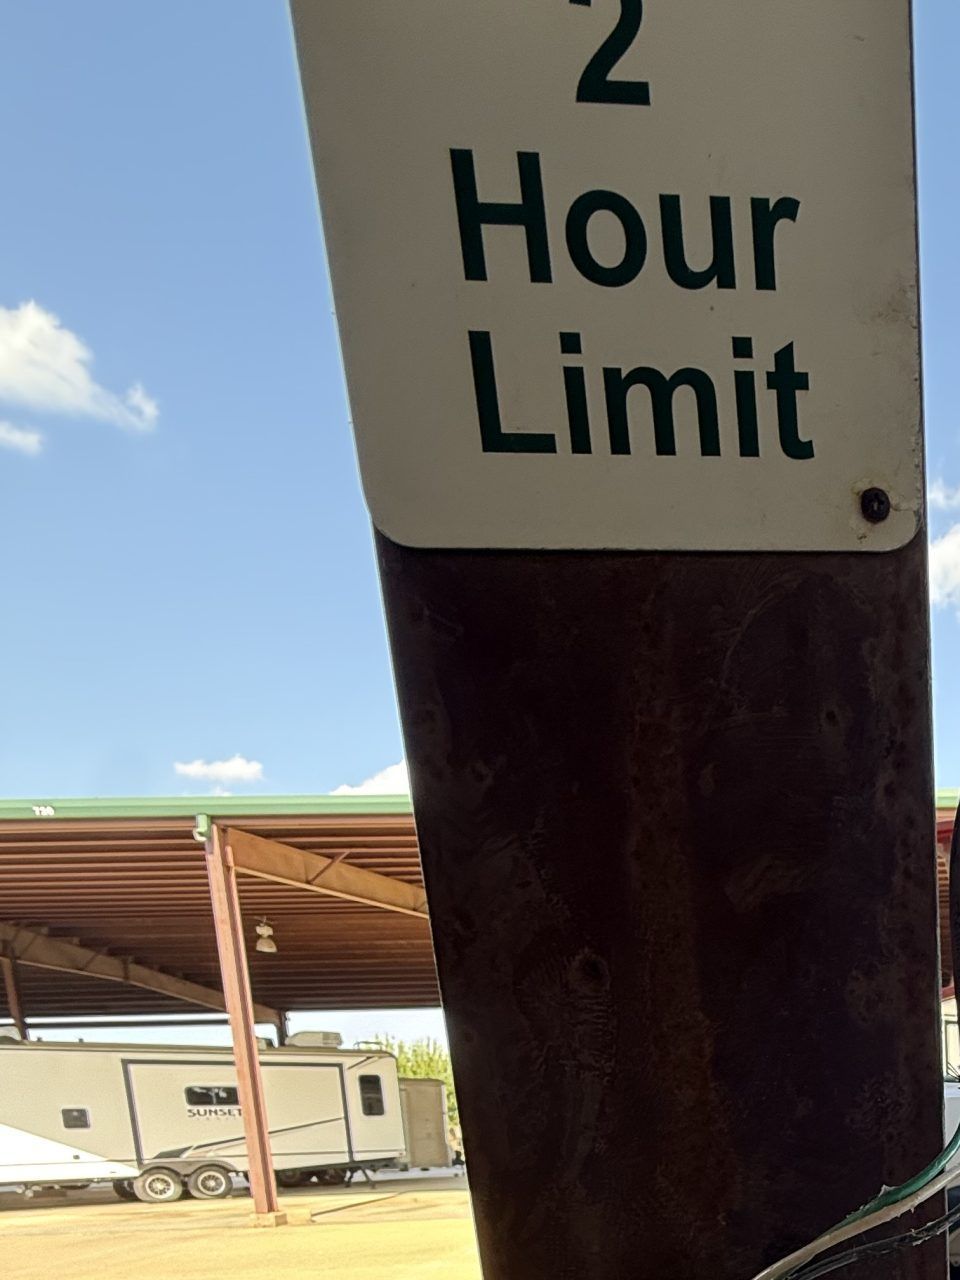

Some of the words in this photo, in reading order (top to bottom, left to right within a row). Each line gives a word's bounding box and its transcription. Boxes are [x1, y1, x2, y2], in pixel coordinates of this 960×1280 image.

[568, 0, 652, 106] 2
[449, 147, 800, 291] Hour
[468, 330, 815, 460] Limit
[187, 1108, 242, 1118] SUNSET
